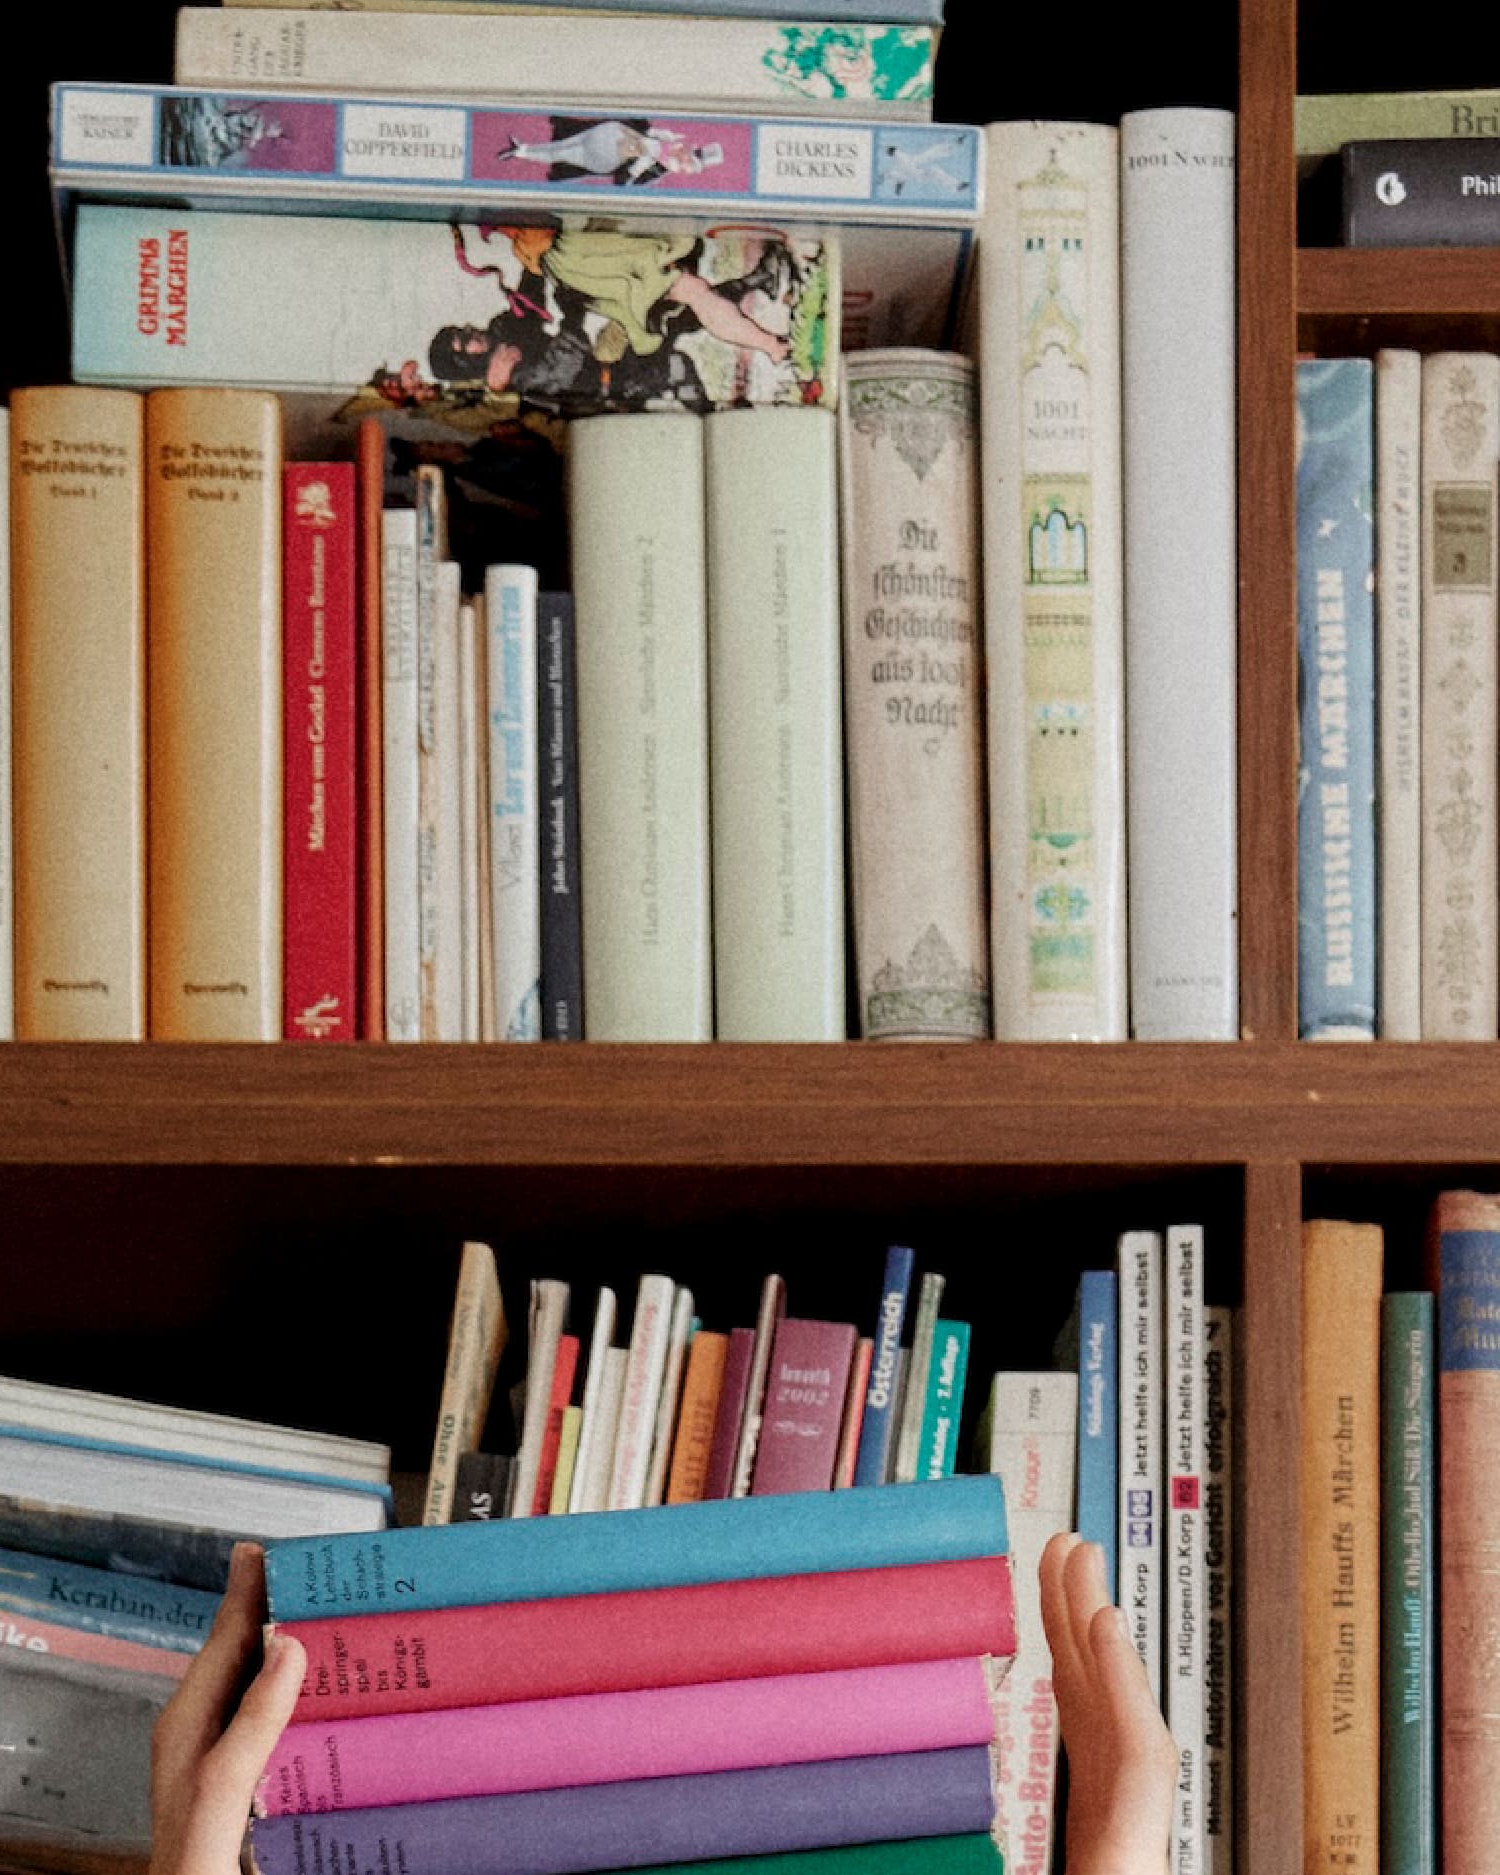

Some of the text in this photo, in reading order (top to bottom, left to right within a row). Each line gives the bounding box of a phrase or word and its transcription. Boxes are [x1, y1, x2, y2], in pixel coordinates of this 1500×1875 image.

[344, 138, 463, 160] COPPERFIELD
[378, 121, 431, 139] DAVID
[774, 140, 859, 161] CHARLES
[776, 158, 858, 180] DICKENS
[136, 237, 162, 337] GRIMMS
[1316, 569, 1354, 986] RUSSISCHE MÄRCHEN
[867, 1291, 905, 1409] Österreich
[1131, 1250, 1152, 1664] ieter Korp Jetzt helfe ich mir selbst
[1175, 1240, 1195, 1829] am Auto Jetzt helfe ich mir selbst
[320, 1544, 337, 1604] Lehrbuch
[394, 1577, 415, 1594] 2
[1329, 1395, 1357, 1736] Wilhelm Hauffs Märchen
[339, 1580, 353, 1602] der
[353, 1658, 371, 1694] spiel
[374, 1670, 389, 1693] bis
[410, 1637, 431, 1689] gambit
